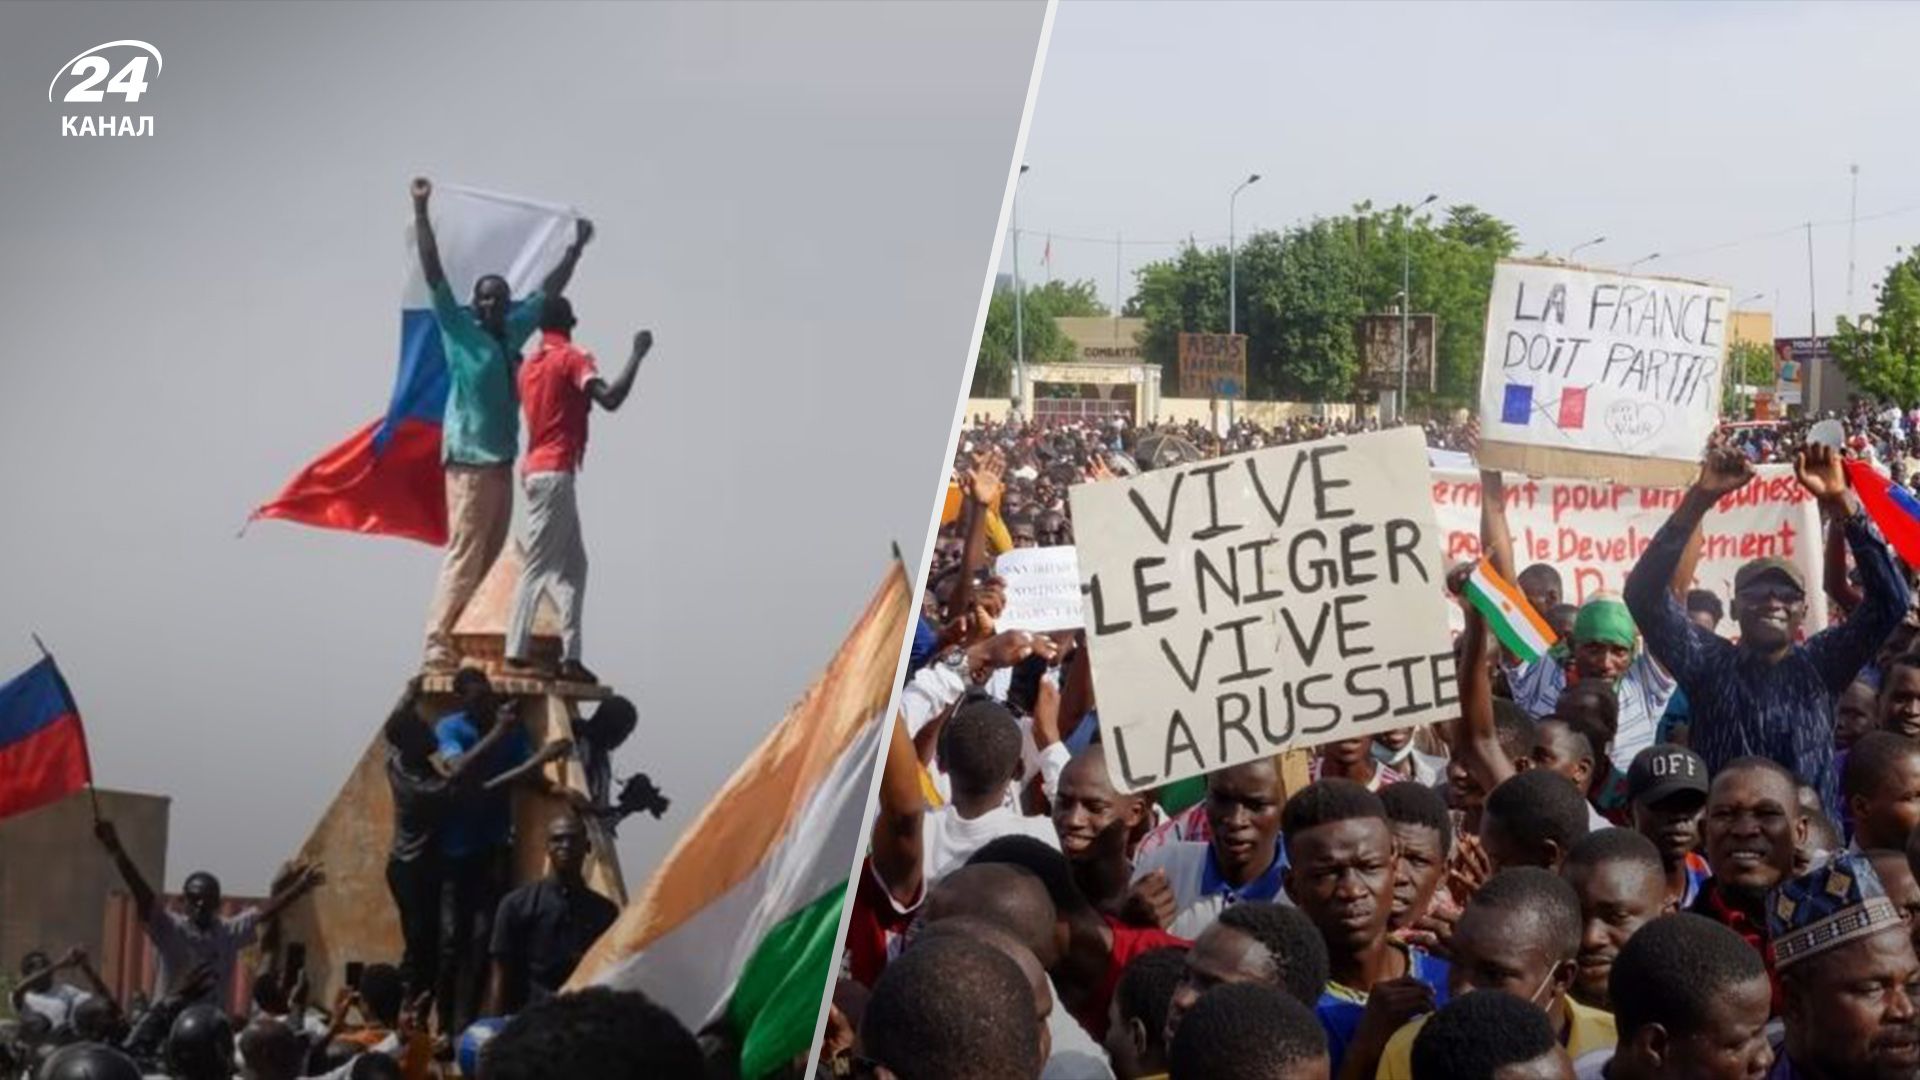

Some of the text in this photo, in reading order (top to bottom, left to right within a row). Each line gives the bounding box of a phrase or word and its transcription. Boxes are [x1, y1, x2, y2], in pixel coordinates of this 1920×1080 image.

[1515, 281, 1725, 346] LA FRANCE
[1601, 342, 1719, 411] PARTIR
[1128, 444, 1355, 544] VIVE
[1553, 483, 1632, 523] pour
[1640, 487, 1686, 511] un
[1081, 518, 1430, 636] LE NIGER
[1525, 526, 1550, 562] le
[1160, 594, 1375, 693] VIVE
[1113, 650, 1459, 790] LA RUSSIE
[1652, 753, 1697, 777] OFF
